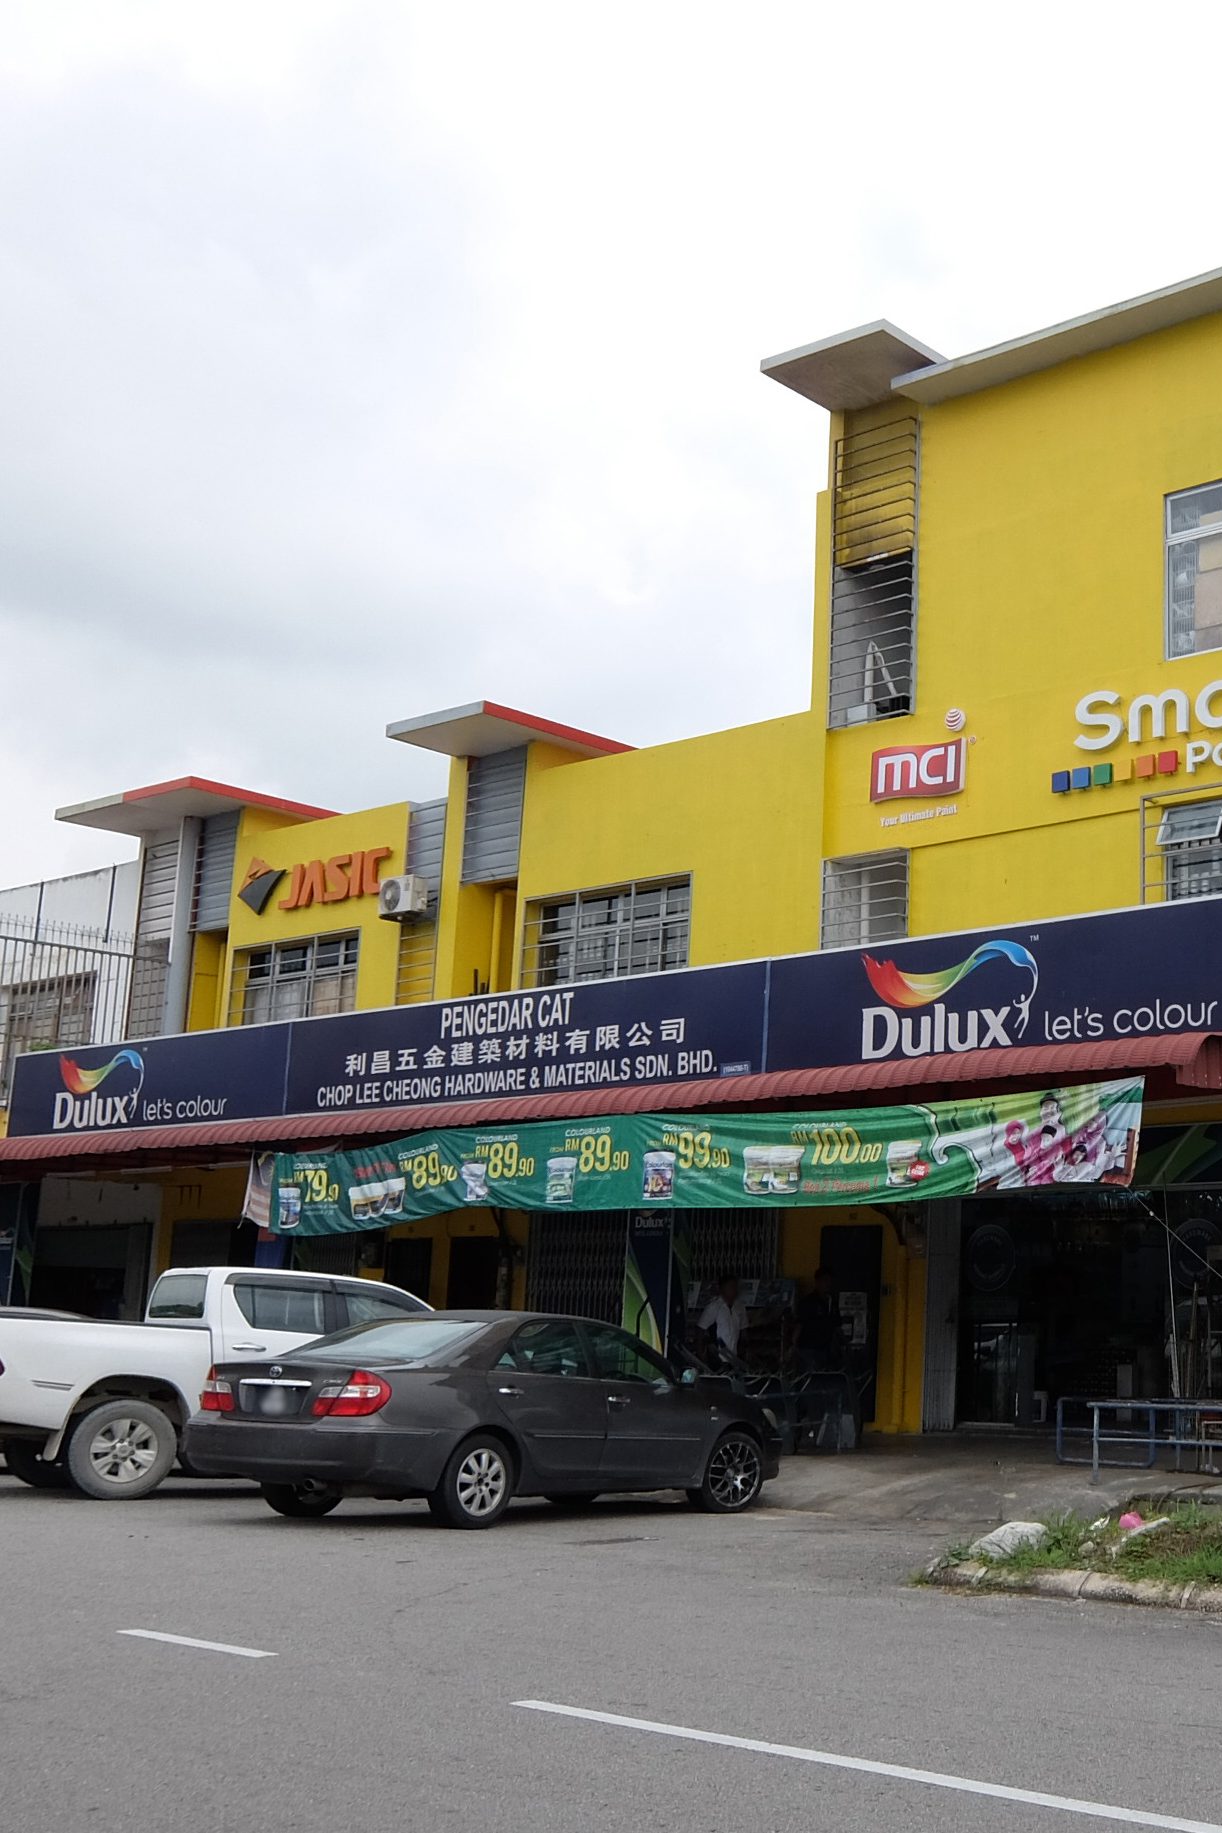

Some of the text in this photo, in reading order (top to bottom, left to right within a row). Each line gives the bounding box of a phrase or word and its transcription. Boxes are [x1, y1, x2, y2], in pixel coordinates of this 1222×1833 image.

[880, 804, 958, 827] Your Ultimate Paint
[278, 846, 392, 911] JASIC
[440, 991, 574, 1039] PENGEDAR CAT
[862, 999, 1218, 1059] Dulux let's colour
[345, 1017, 686, 1077] 利昌五金建築材料有限公司
[317, 1083, 352, 1107] CHOP
[355, 1078, 381, 1104] LEE
[383, 1075, 441, 1102] CHEONG
[444, 1067, 527, 1097] HARDWARE
[529, 1068, 540, 1089] &
[544, 1057, 631, 1088] MATERIALS
[634, 1053, 673, 1084] SDN.
[677, 1050, 718, 1076] BHD.
[52, 1091, 228, 1130] Dulux let's colour
